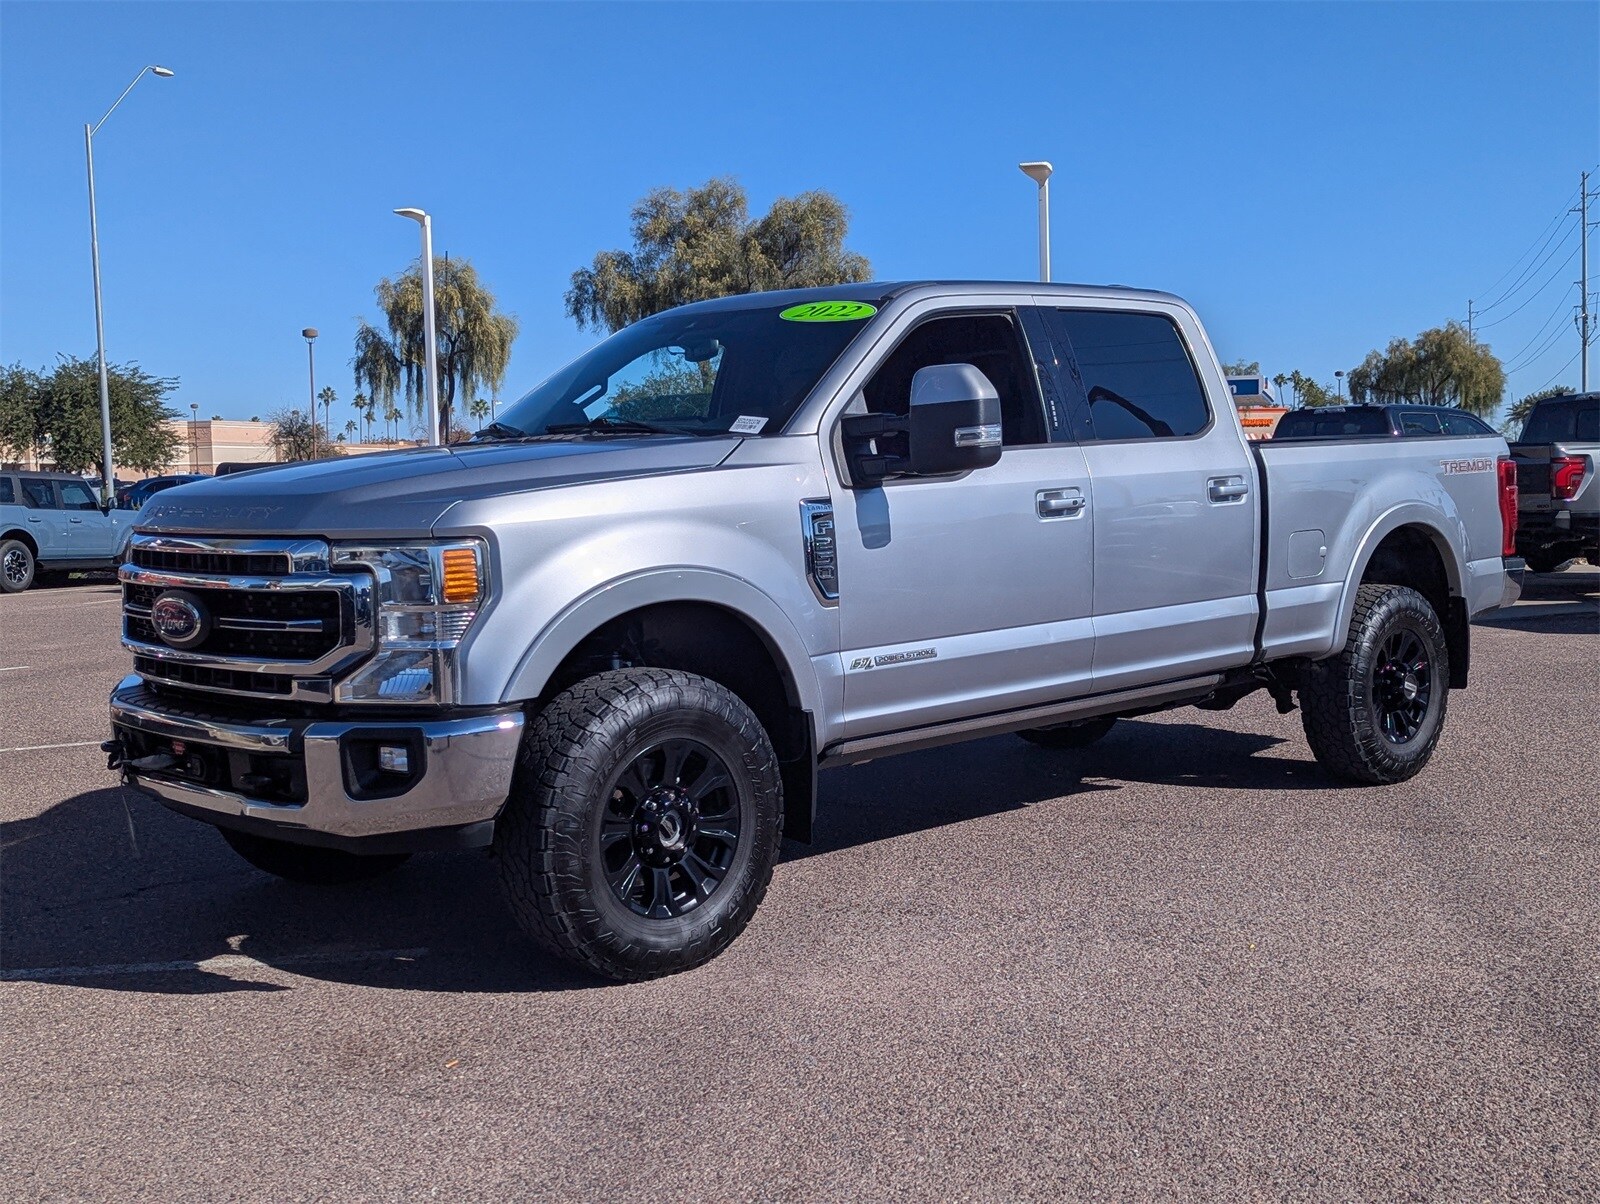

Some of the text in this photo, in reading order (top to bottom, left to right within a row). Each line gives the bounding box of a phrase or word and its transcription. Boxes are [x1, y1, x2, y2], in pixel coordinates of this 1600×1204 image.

[793, 305, 863, 318] 2022
[1440, 457, 1494, 475] TREMOR
[878, 653, 905, 663] POWER
[906, 648, 936, 659] STROKE
